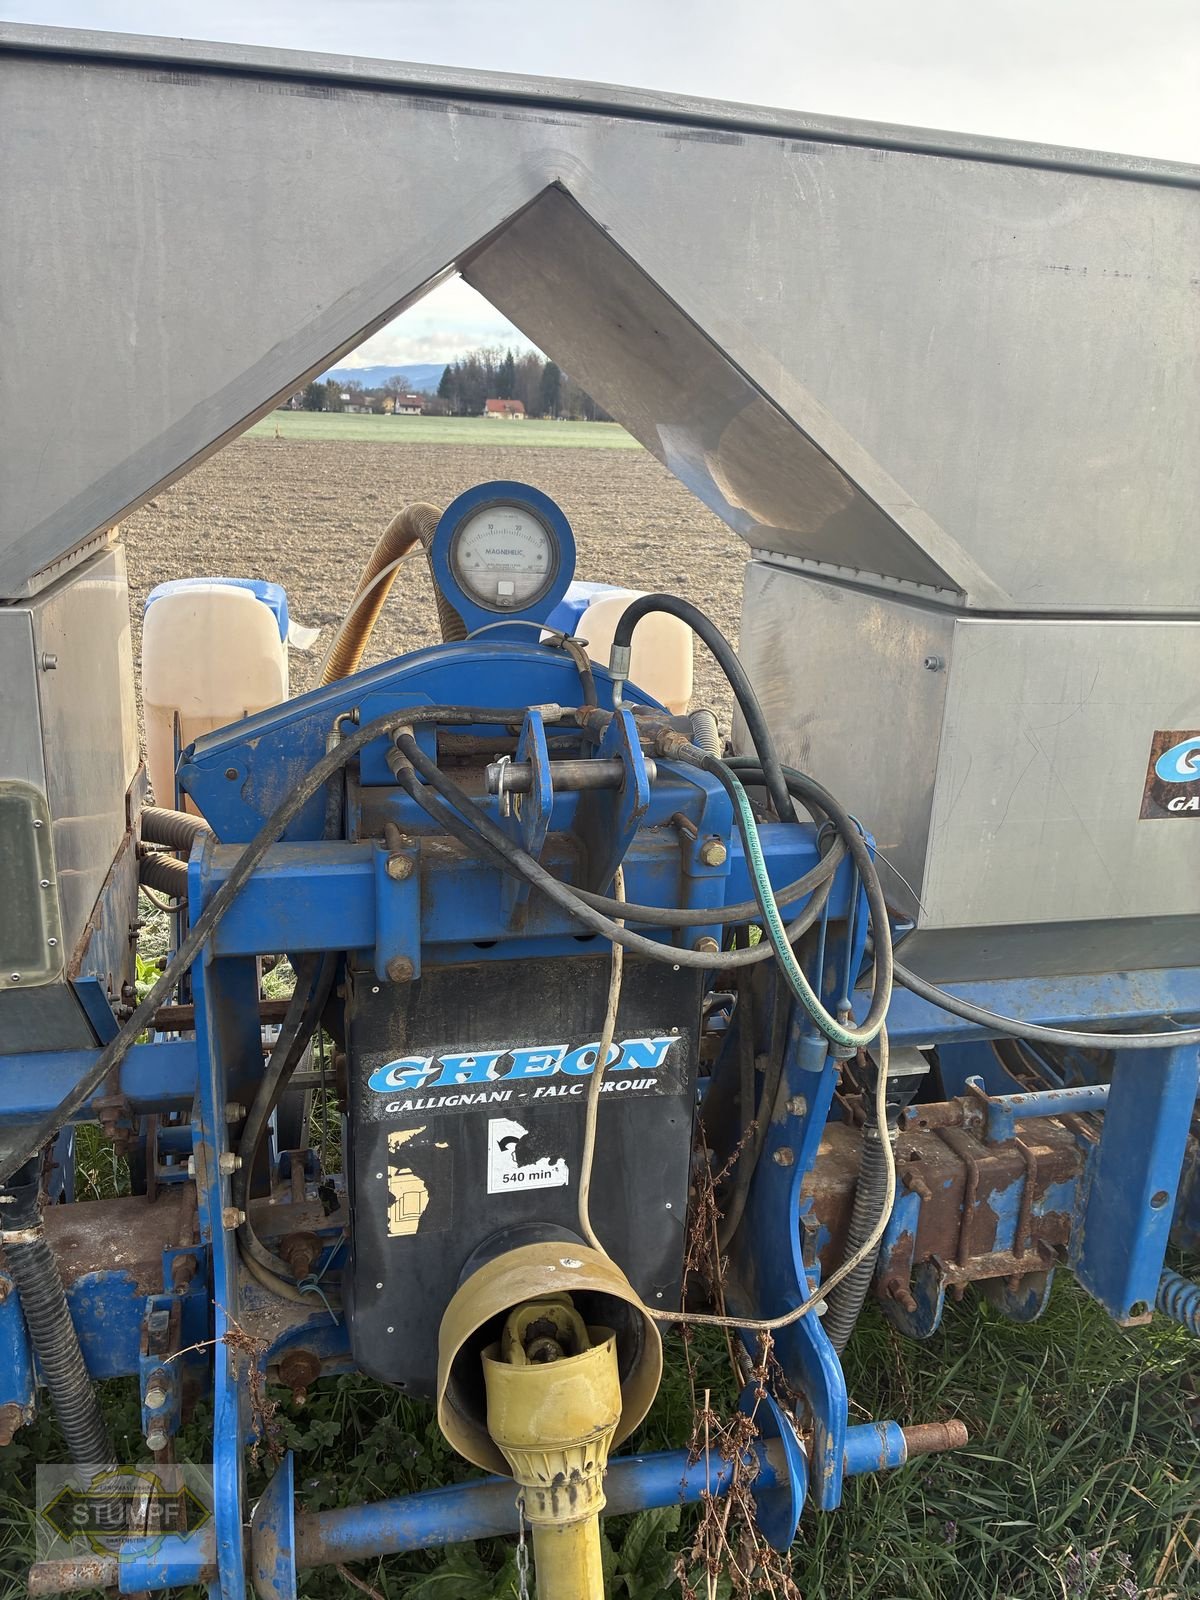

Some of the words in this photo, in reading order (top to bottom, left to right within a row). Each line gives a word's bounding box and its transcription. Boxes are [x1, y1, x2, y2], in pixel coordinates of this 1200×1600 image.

[368, 1036, 682, 1092] GHEON
[385, 1090, 511, 1113] GALLIGNANI
[534, 1083, 583, 1098] FALC
[502, 1172, 525, 1184] 540
